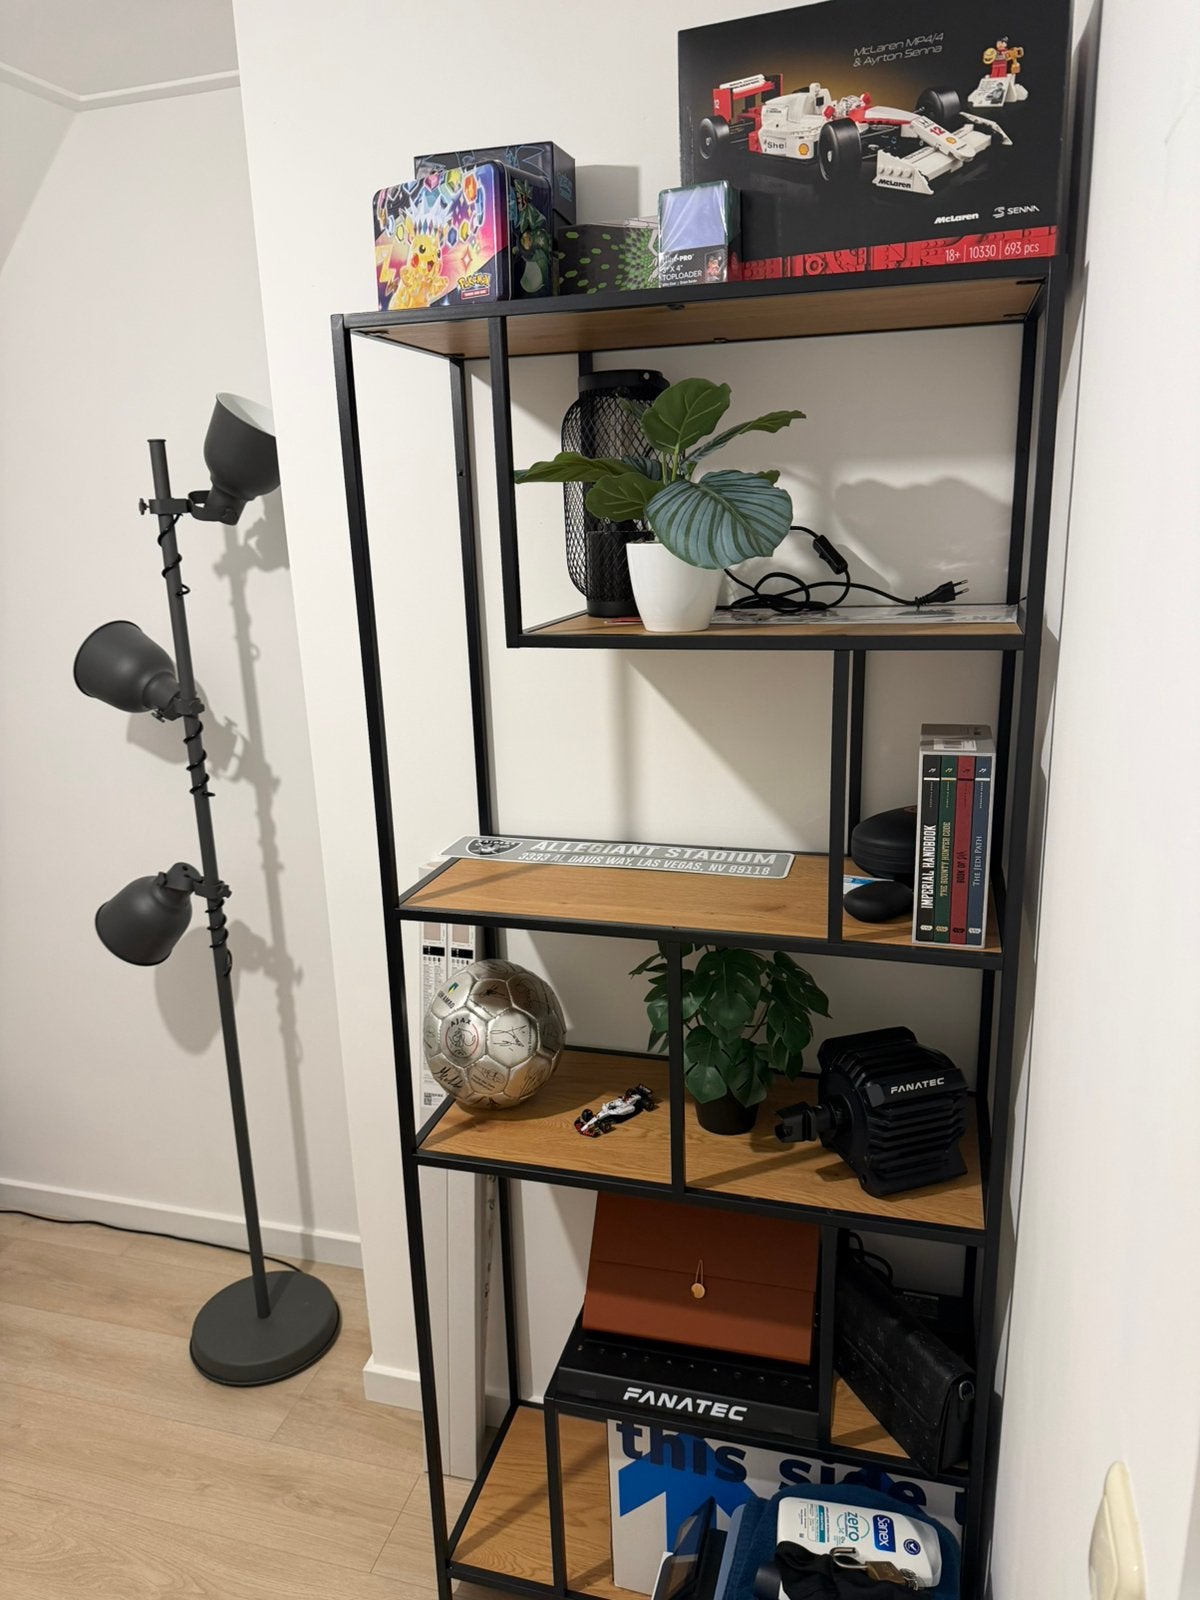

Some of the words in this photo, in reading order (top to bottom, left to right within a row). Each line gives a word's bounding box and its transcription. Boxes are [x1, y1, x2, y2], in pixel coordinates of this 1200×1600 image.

[853, 41, 904, 56] McLaren
[905, 32, 944, 47] MP4/4
[853, 57, 861, 67] &
[863, 52, 903, 66] Ayrton
[904, 45, 943, 58] Senna
[929, 126, 945, 136] 12
[878, 179, 912, 189] McLaren
[933, 212, 980, 224] McLaren
[1007, 205, 1040, 215] SENNA
[945, 248, 961, 262] 18+
[969, 244, 997, 259] 10330
[1004, 241, 1022, 255] 693
[1024, 243, 1040, 256] pcs
[662, 269, 703, 281] TOPLOADER
[943, 821, 951, 837] CODE
[530, 840, 660, 856] ALLEGIANT
[664, 848, 777, 865] STADIUM
[922, 825, 937, 868] HANDBOOK
[941, 837, 950, 861] HUNTER
[518, 852, 551, 861] 3333
[551, 855, 564, 863] AL
[567, 855, 603, 864] DAVIS
[637, 858, 661, 868] LAS
[708, 864, 727, 872] NV
[728, 866, 771, 875] 89118
[940, 862, 949, 885] BOUNTY
[921, 871, 935, 909] IMPERIAL
[940, 885, 948, 897] THE
[450, 1017, 472, 1028] AJAX
[890, 1077, 945, 1095] FANATEC
[622, 1386, 748, 1421] FANATEC
[616, 1419, 748, 1483] this
[847, 1511, 860, 1542] zero
[876, 1516, 891, 1547] Sanex
